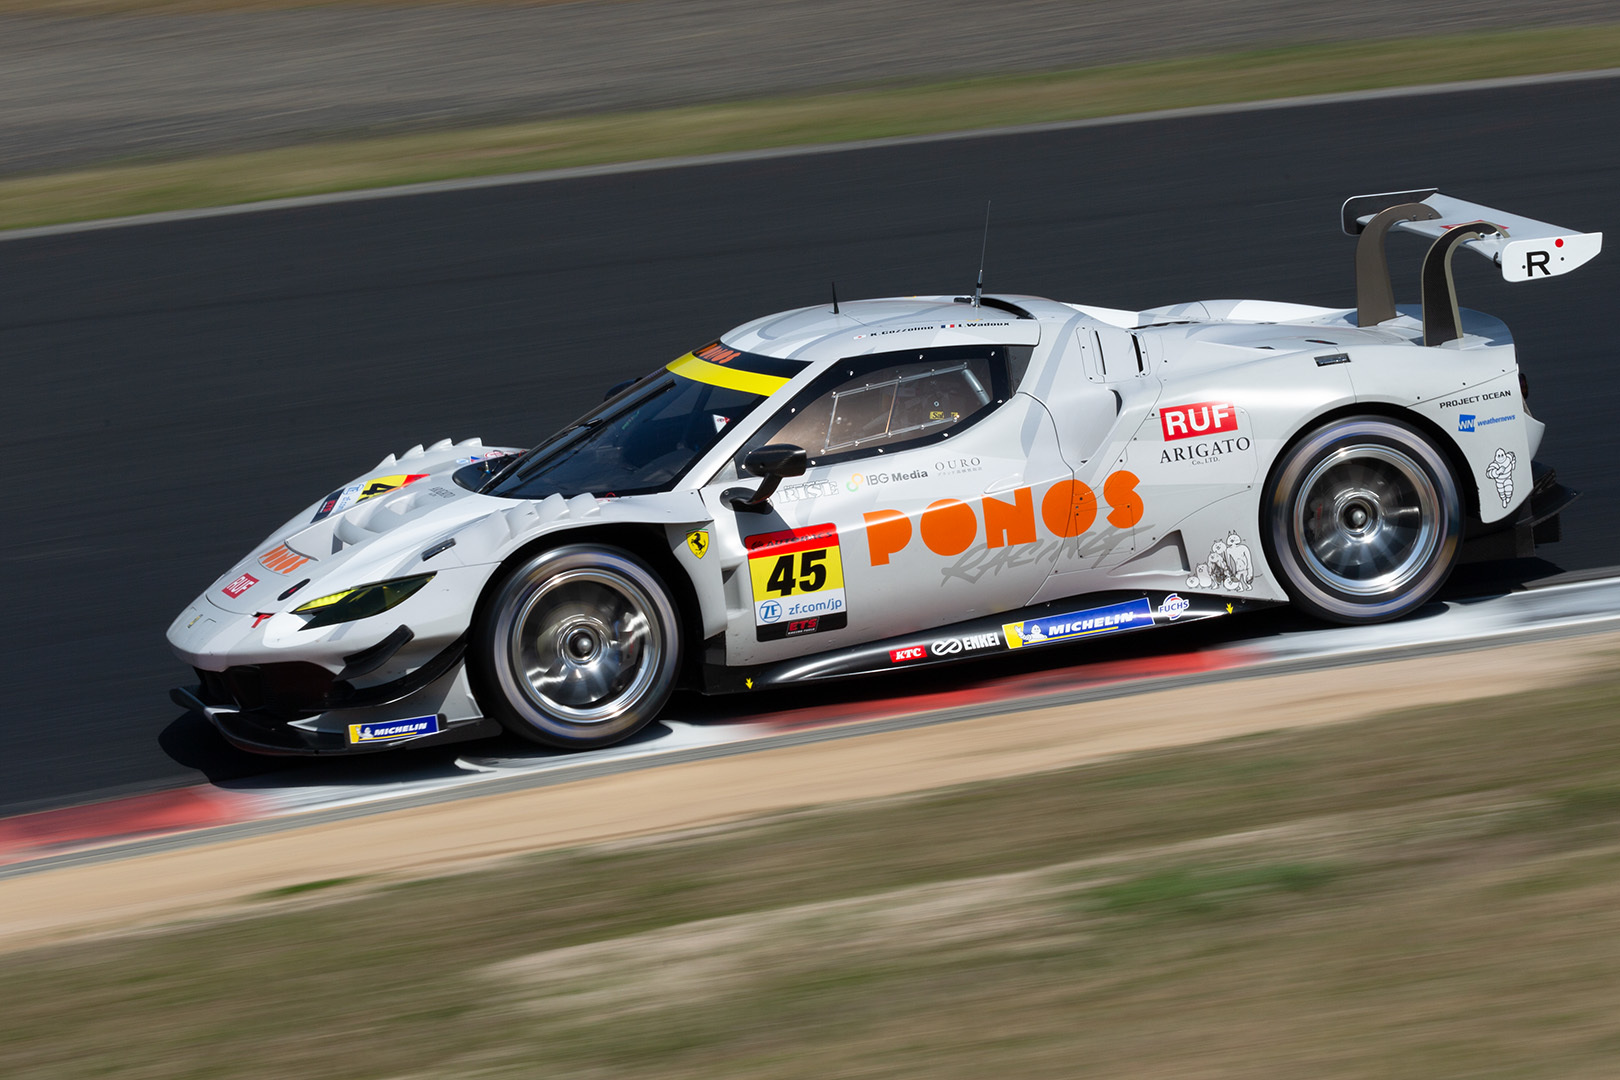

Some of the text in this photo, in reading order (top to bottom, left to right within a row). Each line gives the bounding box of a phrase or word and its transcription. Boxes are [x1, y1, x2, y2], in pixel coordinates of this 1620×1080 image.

[1526, 250, 1551, 277] R
[1439, 390, 1512, 409] PROJECT OCEAN
[1165, 403, 1229, 436] RUF
[1477, 414, 1516, 427] weathernews
[1159, 436, 1251, 464] ARIGATO
[935, 456, 981, 472] OURO
[866, 473, 889, 486] IBG
[892, 469, 928, 482] Media
[863, 470, 1144, 567] PONOS
[766, 549, 828, 597] 45
[226, 575, 255, 595] RUF
[761, 597, 842, 620] ZF zf.com/jp
[1158, 599, 1190, 613] FUCHS
[788, 618, 818, 632] ETS
[1048, 610, 1134, 636] MICHELIN
[963, 632, 1000, 651] ENKEI
[895, 647, 922, 660] KTC
[374, 722, 428, 737] MICHELIN
